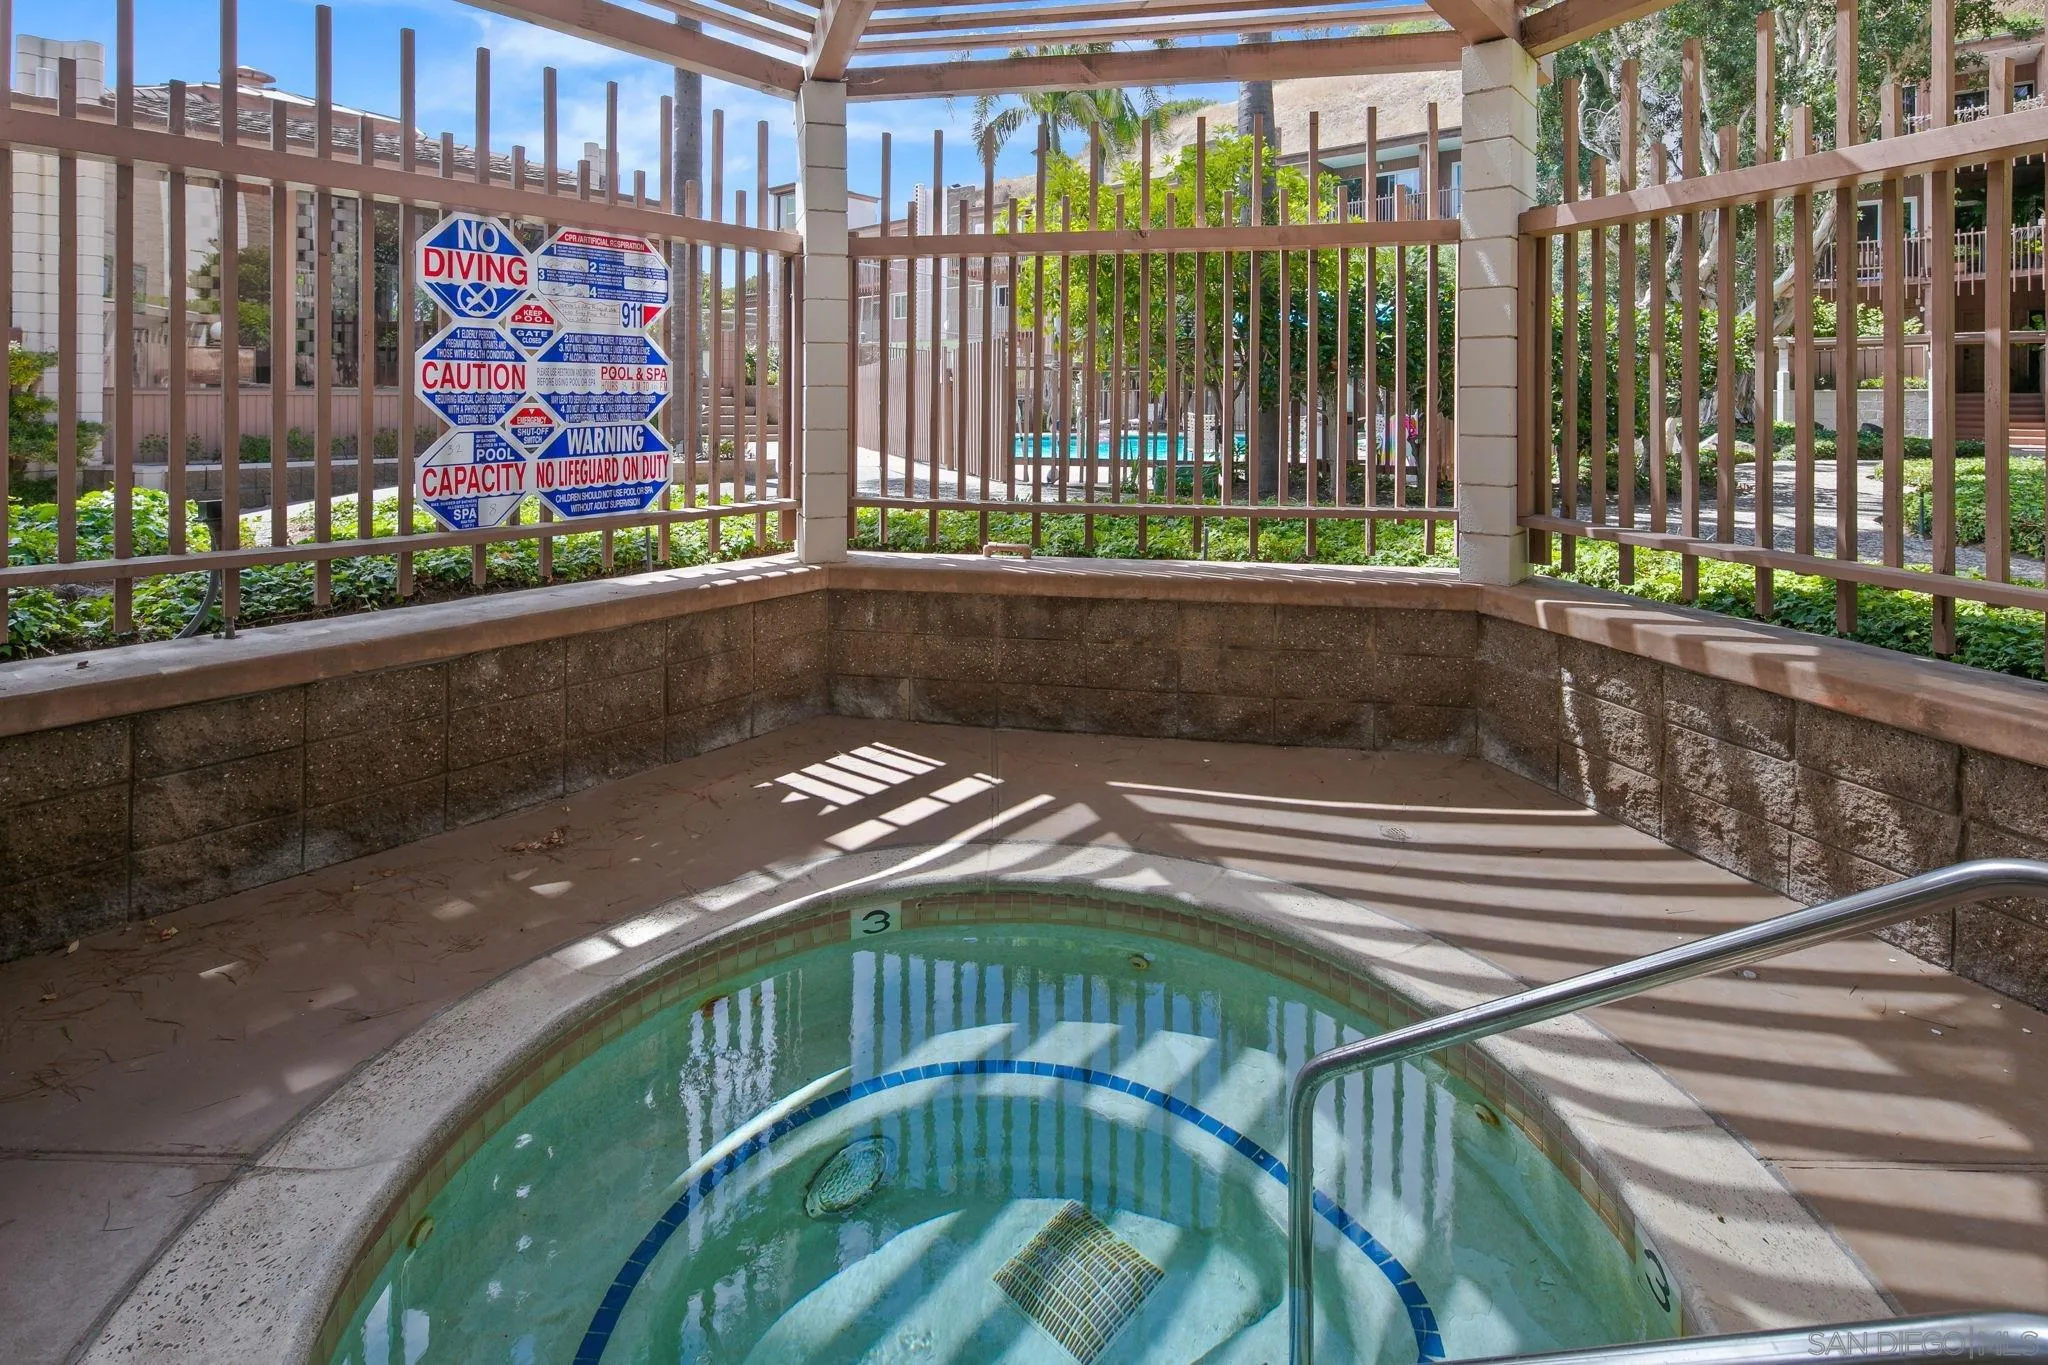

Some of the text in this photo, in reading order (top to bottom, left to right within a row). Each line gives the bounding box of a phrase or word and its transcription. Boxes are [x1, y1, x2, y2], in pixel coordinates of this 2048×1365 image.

[458, 220, 500, 252] NO
[610, 240, 644, 250] RESPIRATION
[424, 248, 528, 286] DIVING
[515, 315, 551, 323] POOL
[622, 302, 642, 328] 911
[462, 329, 478, 339] ELDERLY
[446, 339, 466, 348] PREGNANT
[483, 340, 498, 349] INFANTS
[498, 341, 506, 350] AND
[582, 335, 597, 344] SWALLOW
[436, 349, 515, 360] THOSE WITH HEALTH CONDITIONS
[603, 345, 612, 354] WHILE
[613, 346, 623, 354] UNDER
[632, 346, 650, 355] INFLUENCE
[563, 353, 568, 361] OF
[610, 355, 622, 363] DRUGS
[623, 355, 628, 363] OR
[422, 361, 525, 390] CAUTION
[601, 366, 667, 381] POOL & SPA
[537, 378, 554, 386] BEFORE
[601, 381, 618, 391] HOURS
[643, 382, 649, 391] TO
[435, 395, 519, 404] REQUIRING MEDICAL CARE SHOULD CONSULT
[559, 395, 568, 404] LEAD
[568, 395, 573, 404] TO
[574, 395, 588, 404] SERIOUS
[588, 395, 614, 404] CONSEQUENCES
[632, 395, 656, 404] RECOMMENDED
[448, 405, 460, 414] WITH
[464, 405, 488, 414] PHYSICIAN
[489, 405, 506, 413] BEFORE
[638, 404, 650, 412] RESULT
[458, 415, 496, 424] ENTERING THE SPA
[518, 428, 549, 436] SHUT-OFF
[524, 436, 542, 444] SWITCH
[567, 426, 644, 455] WARNING
[476, 448, 515, 461] POOL
[537, 454, 669, 488] NO LIFEGUARD ON DUTY
[422, 462, 526, 497] CAPACITY
[556, 494, 581, 503] CHILDREN
[582, 491, 602, 500] SHOULD
[603, 490, 612, 498] NOT
[624, 488, 636, 496] POOL
[644, 486, 653, 494] SPA
[570, 498, 640, 512] WITHOUT ADULT SUPERVISION
[454, 508, 477, 520] SPA
[862, 910, 890, 934] 3
